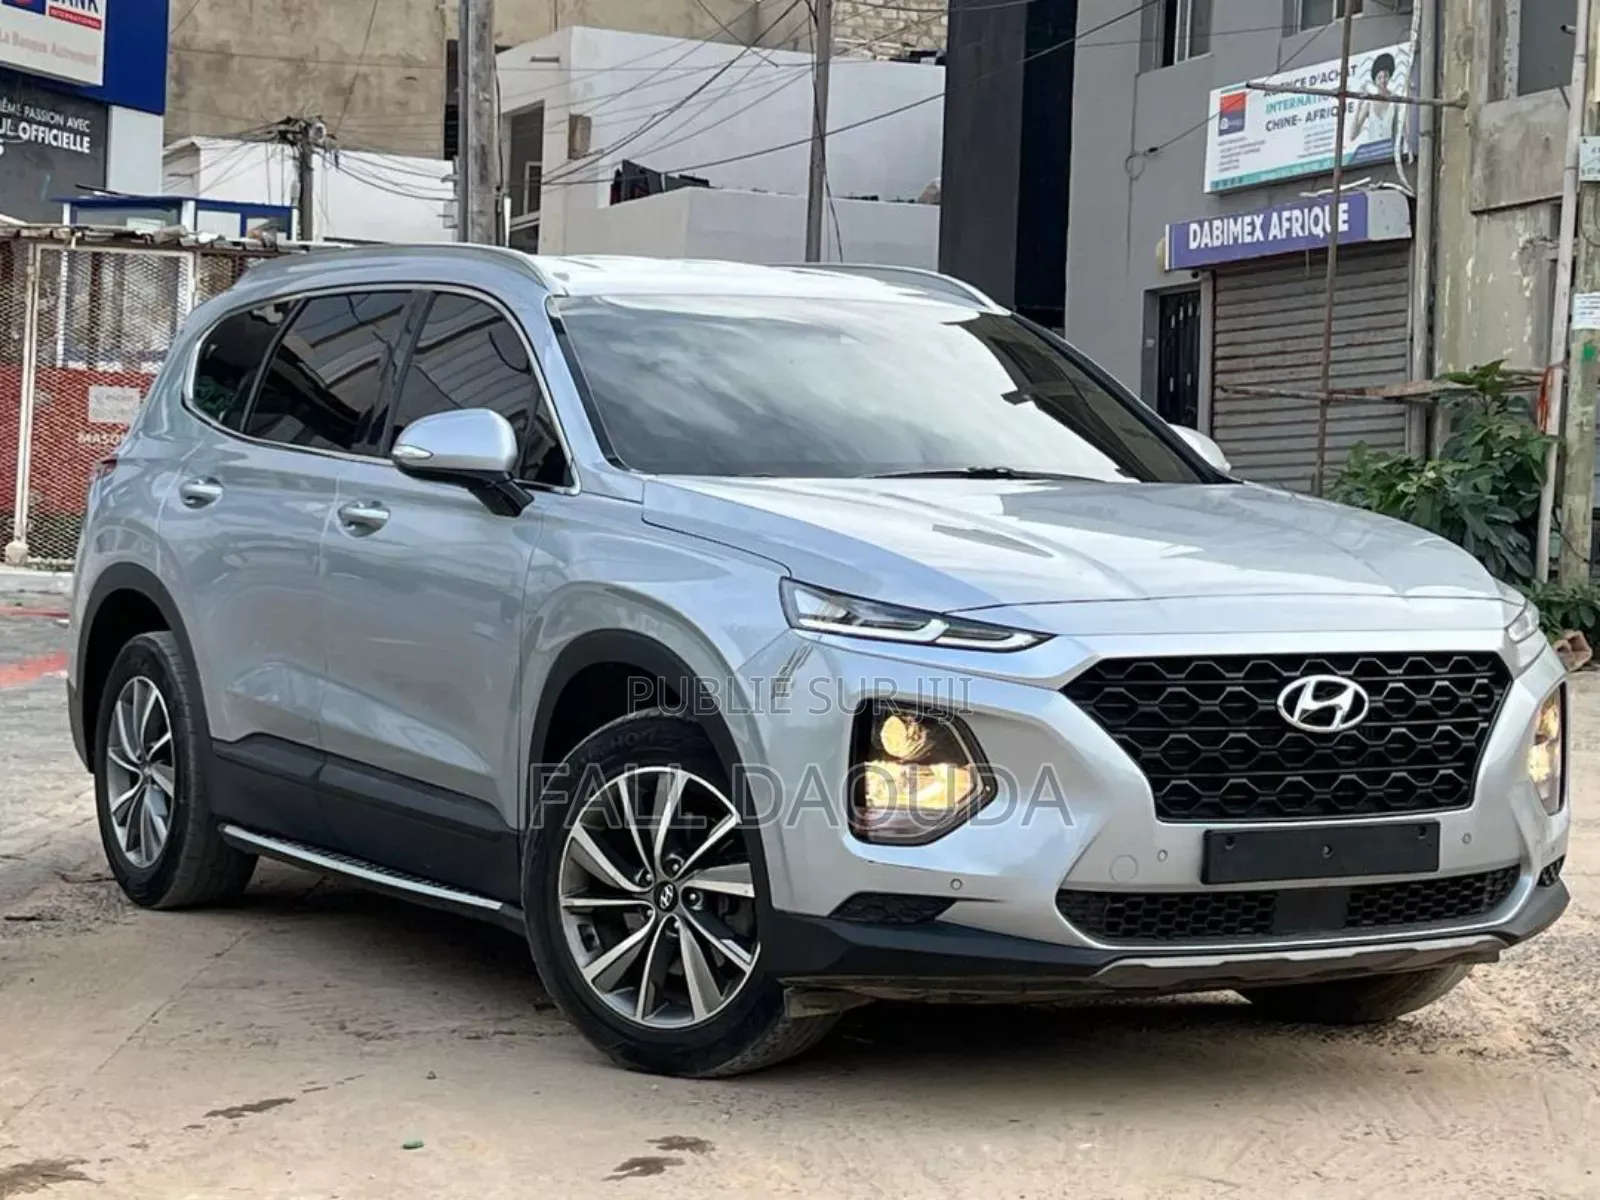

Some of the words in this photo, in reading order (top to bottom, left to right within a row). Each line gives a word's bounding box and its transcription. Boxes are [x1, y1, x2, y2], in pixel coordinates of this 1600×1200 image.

[1309, 64, 1358, 87] D'ACHT
[24, 105, 64, 126] PASSION
[66, 115, 91, 133] AVEC
[1305, 101, 1355, 123] AFRIQE
[18, 121, 91, 154] OFFICIELLE
[1188, 213, 1265, 250] DABIMEX
[1268, 202, 1349, 242] AFRIQUE
